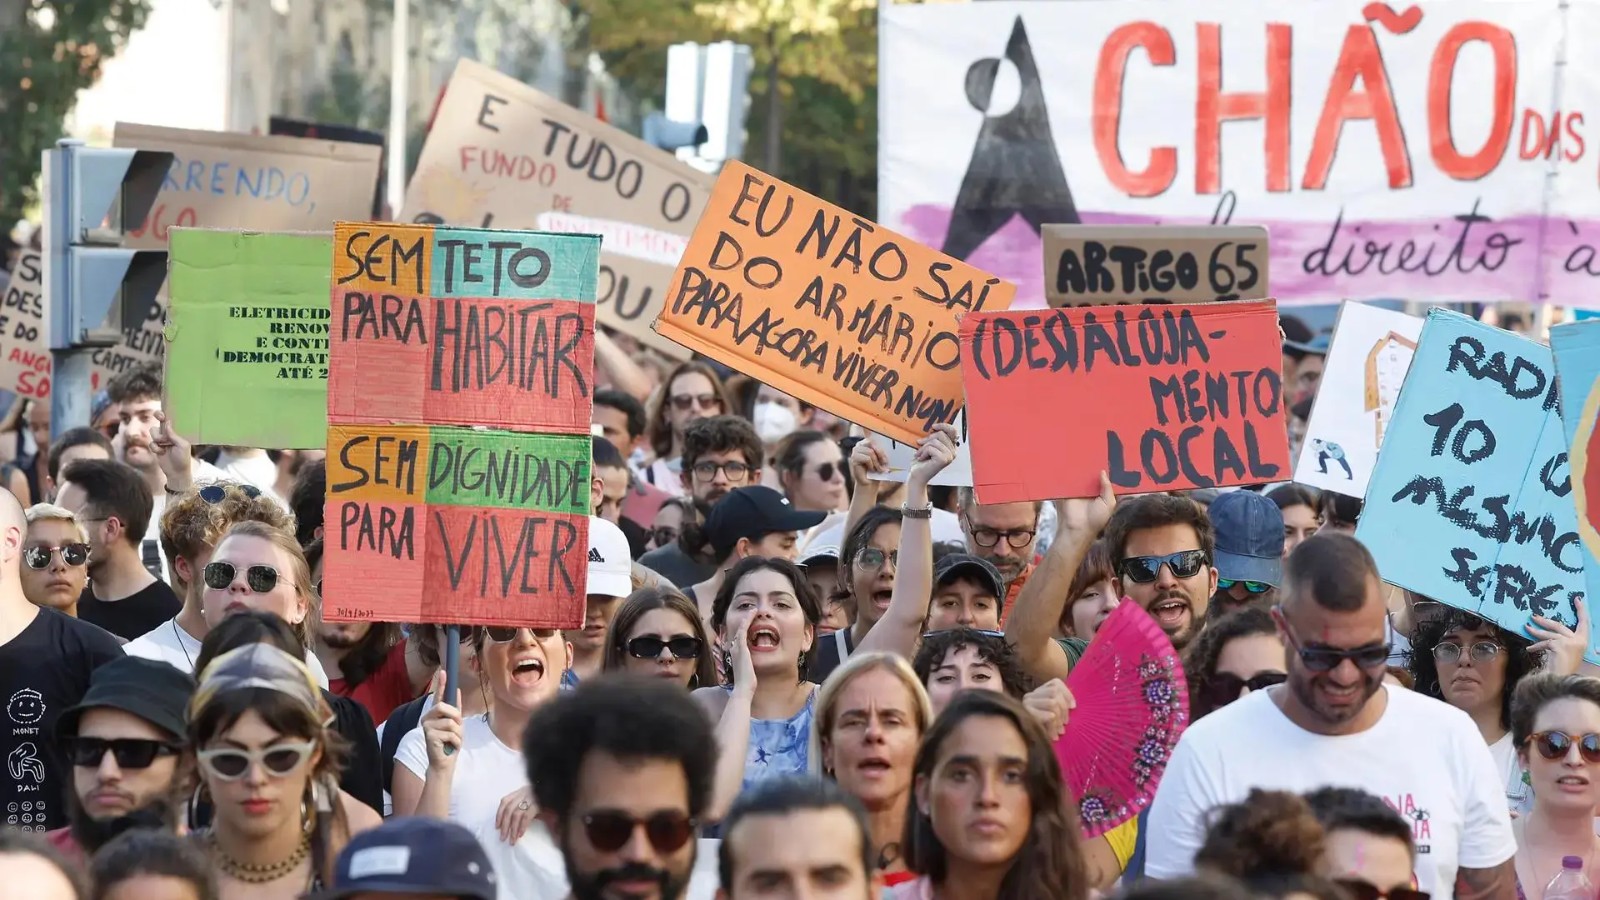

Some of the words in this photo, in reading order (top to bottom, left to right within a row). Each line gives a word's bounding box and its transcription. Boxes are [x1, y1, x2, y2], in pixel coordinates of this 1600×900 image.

[1092, 1, 1518, 198] CHÃO
[1519, 107, 1585, 163] DAS
[459, 145, 557, 188] FUNDO
[477, 94, 509, 133] E
[542, 119, 643, 200] TUDO
[661, 182, 691, 223] O
[552, 194, 573, 212] DE
[338, 231, 423, 295] SEM
[437, 239, 552, 296] TETO
[708, 231, 782, 290] DO
[729, 173, 794, 237] EU
[795, 208, 908, 281] NÃO
[913, 262, 1001, 311] SAÍ
[1303, 197, 1524, 277] direito
[1208, 242, 1258, 294] 65
[14, 321, 38, 342] DO
[229, 307, 331, 319] ELETRICID
[256, 337, 268, 348] E
[272, 337, 330, 350] CONT
[276, 366, 313, 379] ATÉ
[341, 292, 428, 345] PARA
[430, 303, 589, 399] HABITAR
[672, 267, 743, 345] PARA
[735, 307, 829, 374] AGORA
[832, 347, 900, 410] VIVER
[894, 385, 960, 433] NUM
[1149, 366, 1283, 426] MENTO
[1106, 420, 1281, 489] LOCAL
[1423, 402, 1496, 465] 10
[331, 436, 419, 495] SEM
[341, 501, 414, 560] PARA
[435, 510, 576, 598] VIVER
[12, 727, 40, 736] MONET
[17, 784, 40, 792] DALI
